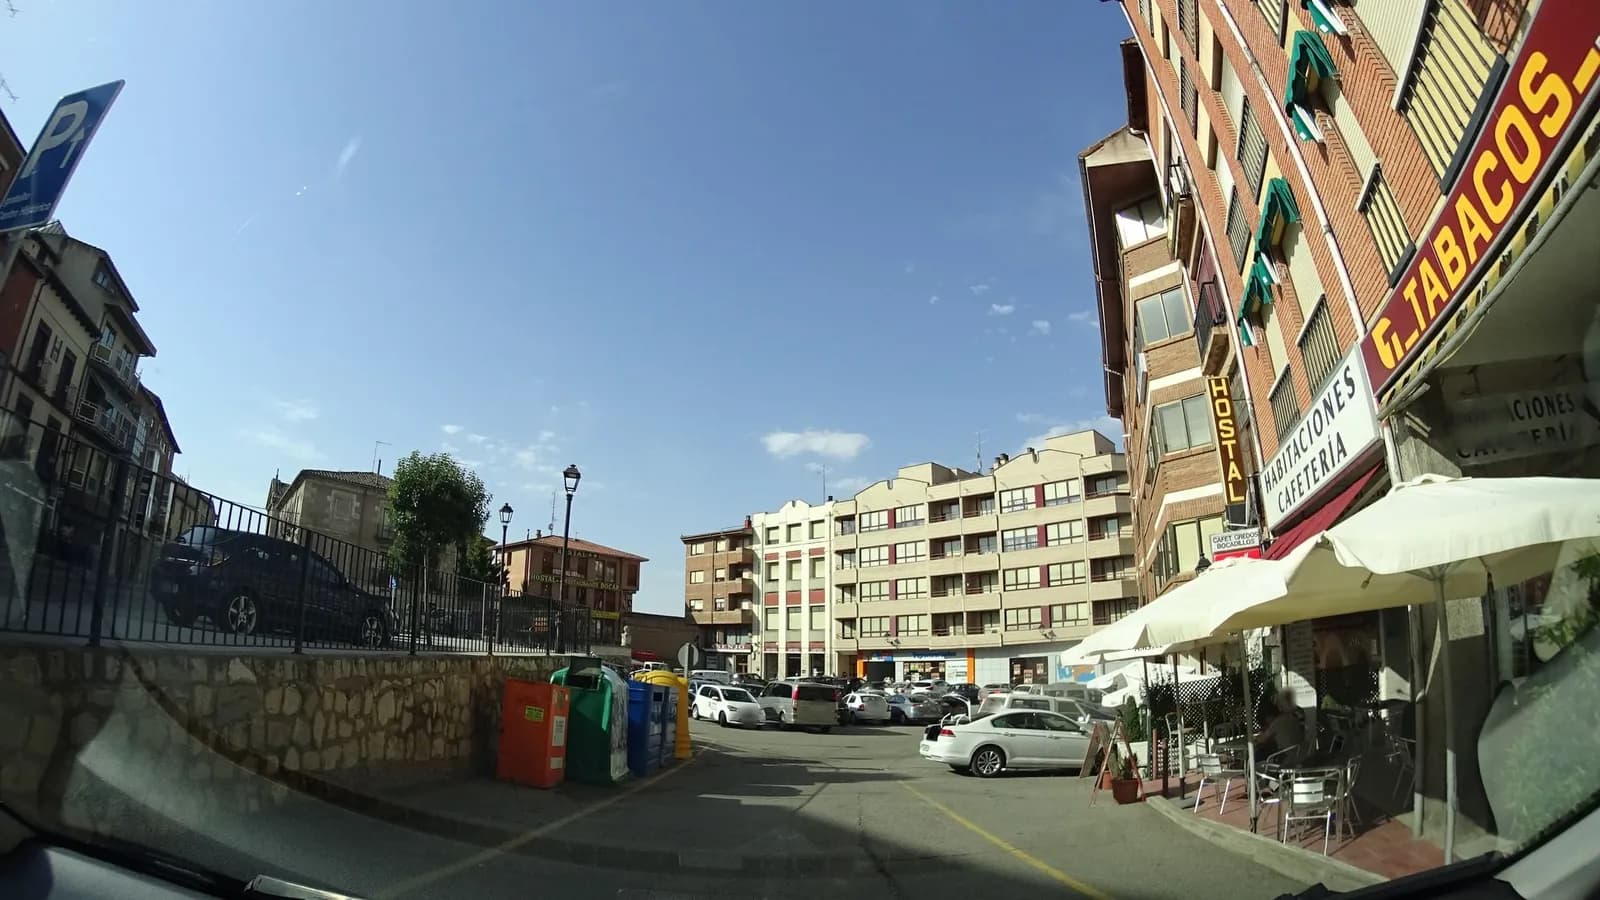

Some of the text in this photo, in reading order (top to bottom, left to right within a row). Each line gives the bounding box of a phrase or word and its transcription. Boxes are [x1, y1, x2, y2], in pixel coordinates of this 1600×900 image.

[20, 100, 89, 179] P
[1210, 379, 1244, 503] HOSTAL
[1264, 365, 1356, 494] HABITACIONES
[1278, 432, 1348, 513] CAFETERÍA
[531, 573, 556, 584] HOSTAL
[1216, 538, 1255, 549] BOCADILLOS
